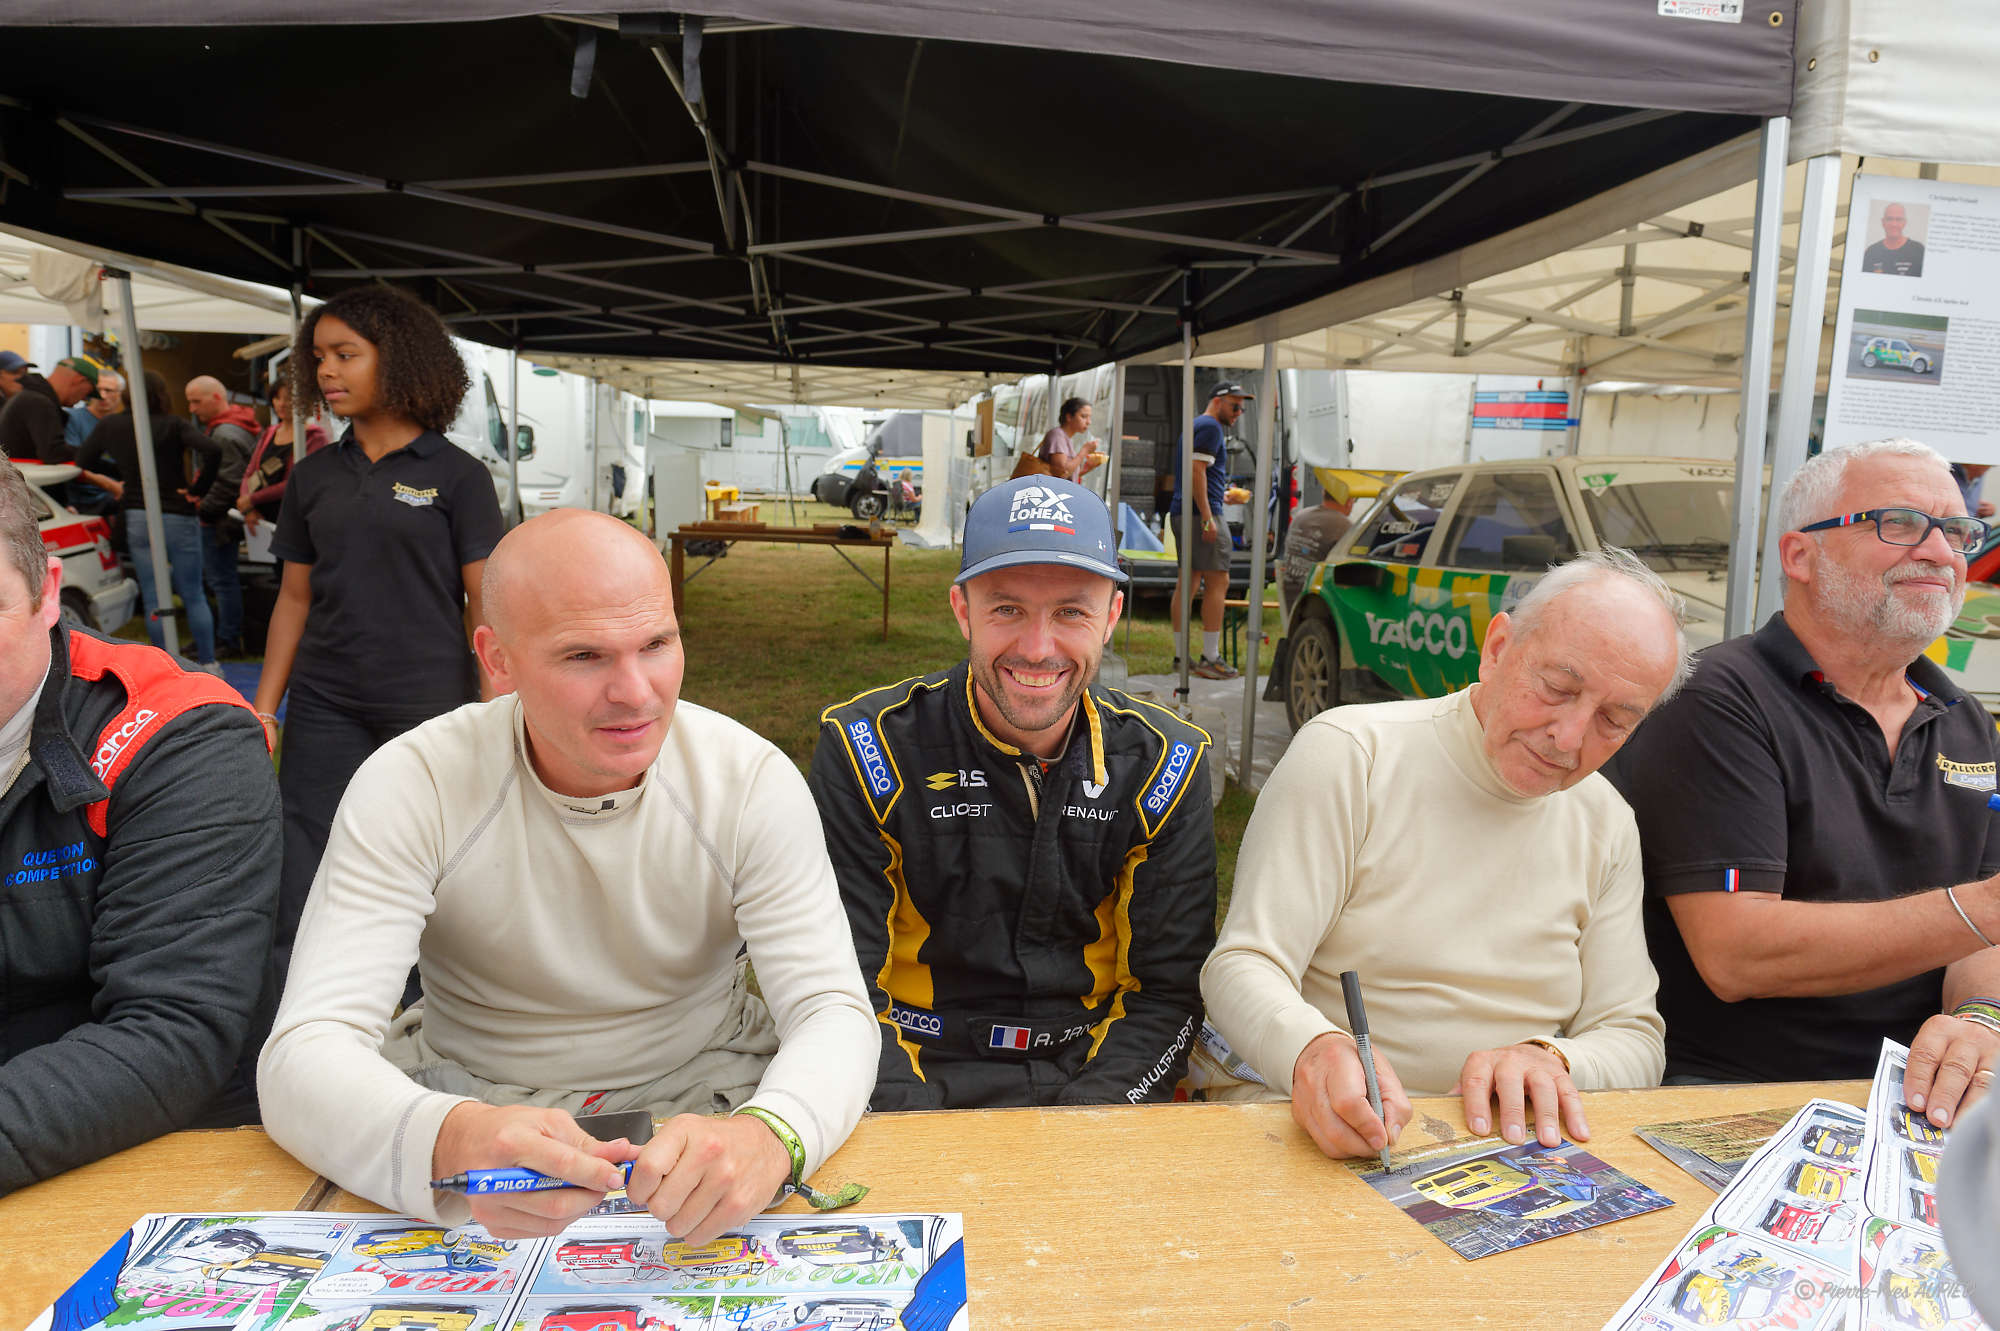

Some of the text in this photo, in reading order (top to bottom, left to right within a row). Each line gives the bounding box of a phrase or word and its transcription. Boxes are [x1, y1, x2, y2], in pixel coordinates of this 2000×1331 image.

[1010, 486, 1074, 513] RX
[1008, 508, 1074, 524] LOHEAC
[1365, 610, 1467, 660] YACCO
[90, 709, 154, 777] parco
[853, 721, 891, 792] sparco
[1943, 761, 1995, 773] RALLYCRO
[1147, 744, 1188, 809] sparco
[23, 841, 84, 866] QUEON
[889, 1006, 941, 1032] parco
[1033, 1022, 1098, 1048] A. JAN
[494, 1179, 535, 1191] PILOT
